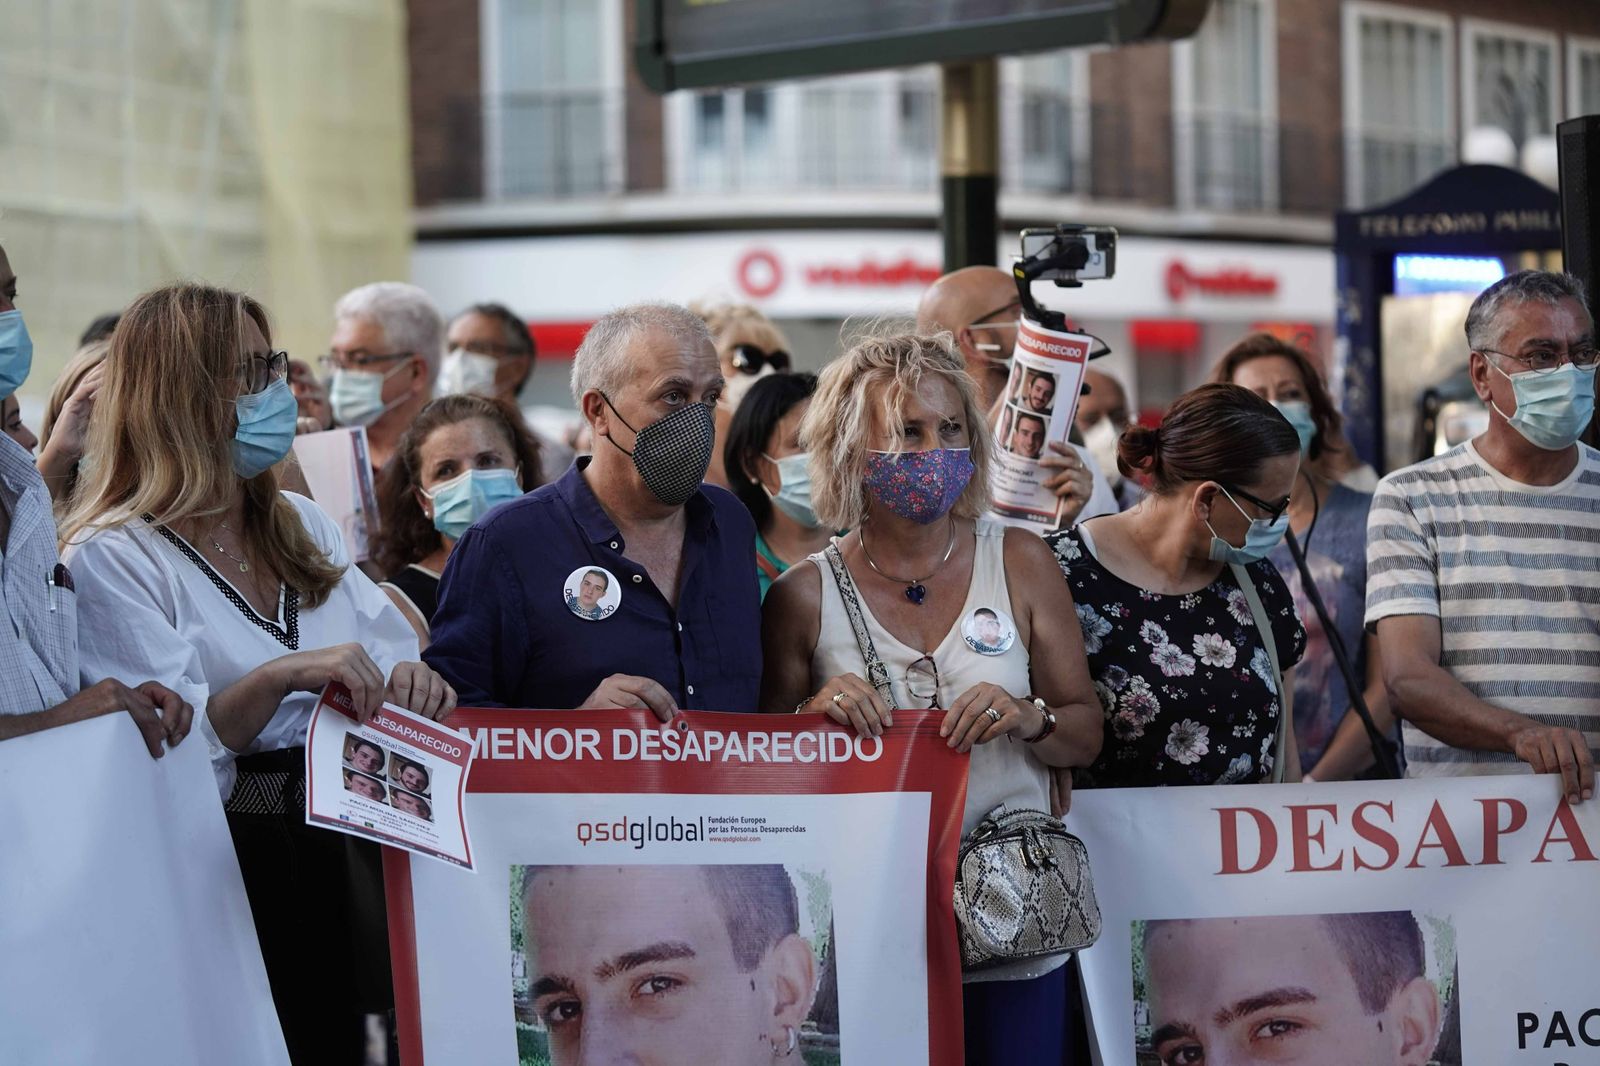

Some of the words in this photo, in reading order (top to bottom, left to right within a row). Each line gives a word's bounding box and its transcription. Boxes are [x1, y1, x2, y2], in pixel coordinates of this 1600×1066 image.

[372, 713, 462, 758] DESAPARECIDO
[459, 727, 603, 762] MENOR
[612, 728, 884, 764] DESAPARECIDO
[577, 815, 704, 850] qsdglobal
[708, 816, 739, 824] Fundación
[740, 816, 767, 825] Europea
[708, 826, 718, 834] por
[720, 825, 729, 833] las
[730, 825, 758, 833] Personas
[760, 825, 806, 834] Desaparecidas
[1211, 798, 1600, 875] DESAPA
[709, 835, 762, 843] www.qsdglobal.com
[1517, 1008, 1600, 1049] PAC
